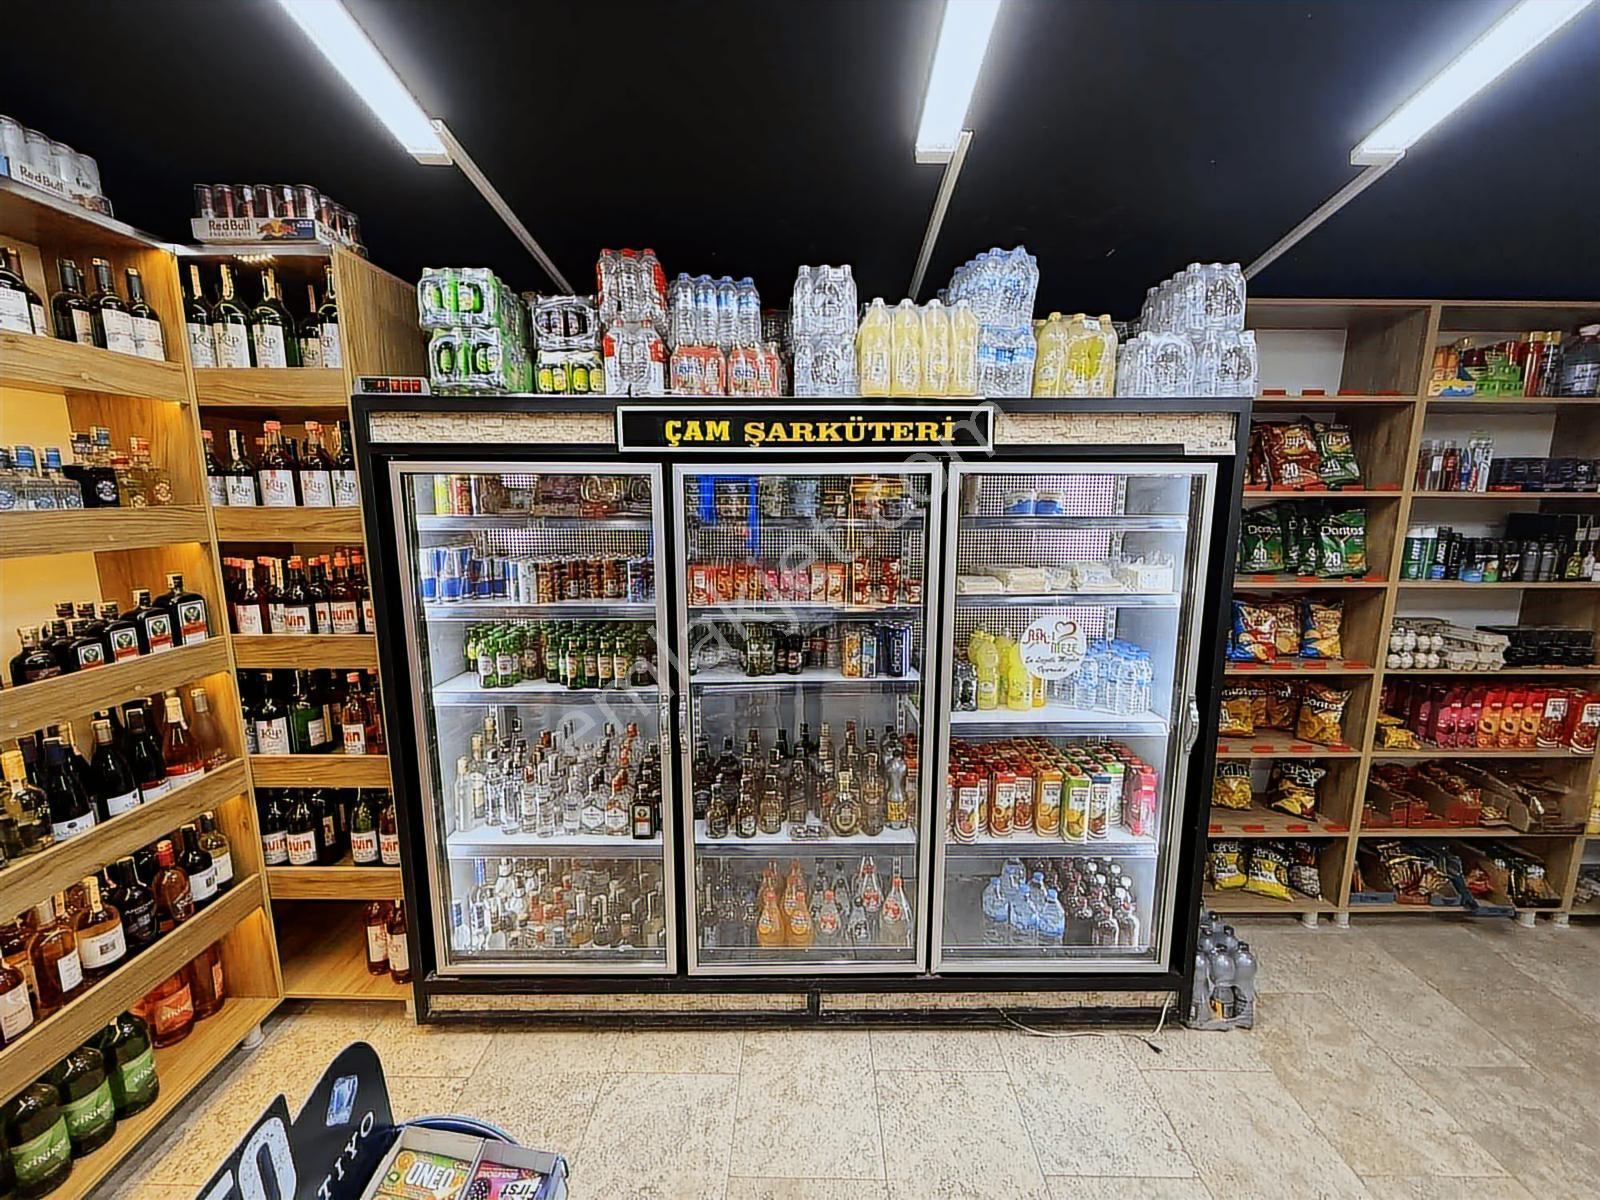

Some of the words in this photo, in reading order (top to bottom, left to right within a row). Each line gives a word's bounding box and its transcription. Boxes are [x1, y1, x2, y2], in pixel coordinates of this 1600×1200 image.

[208, 219, 229, 231] Red
[230, 218, 250, 231] Bull
[665, 419, 730, 446] ÇAM
[744, 416, 956, 447] ŞARKÜTERİ
[1321, 525, 1364, 536] Doritos
[892, 639, 902, 673] deep
